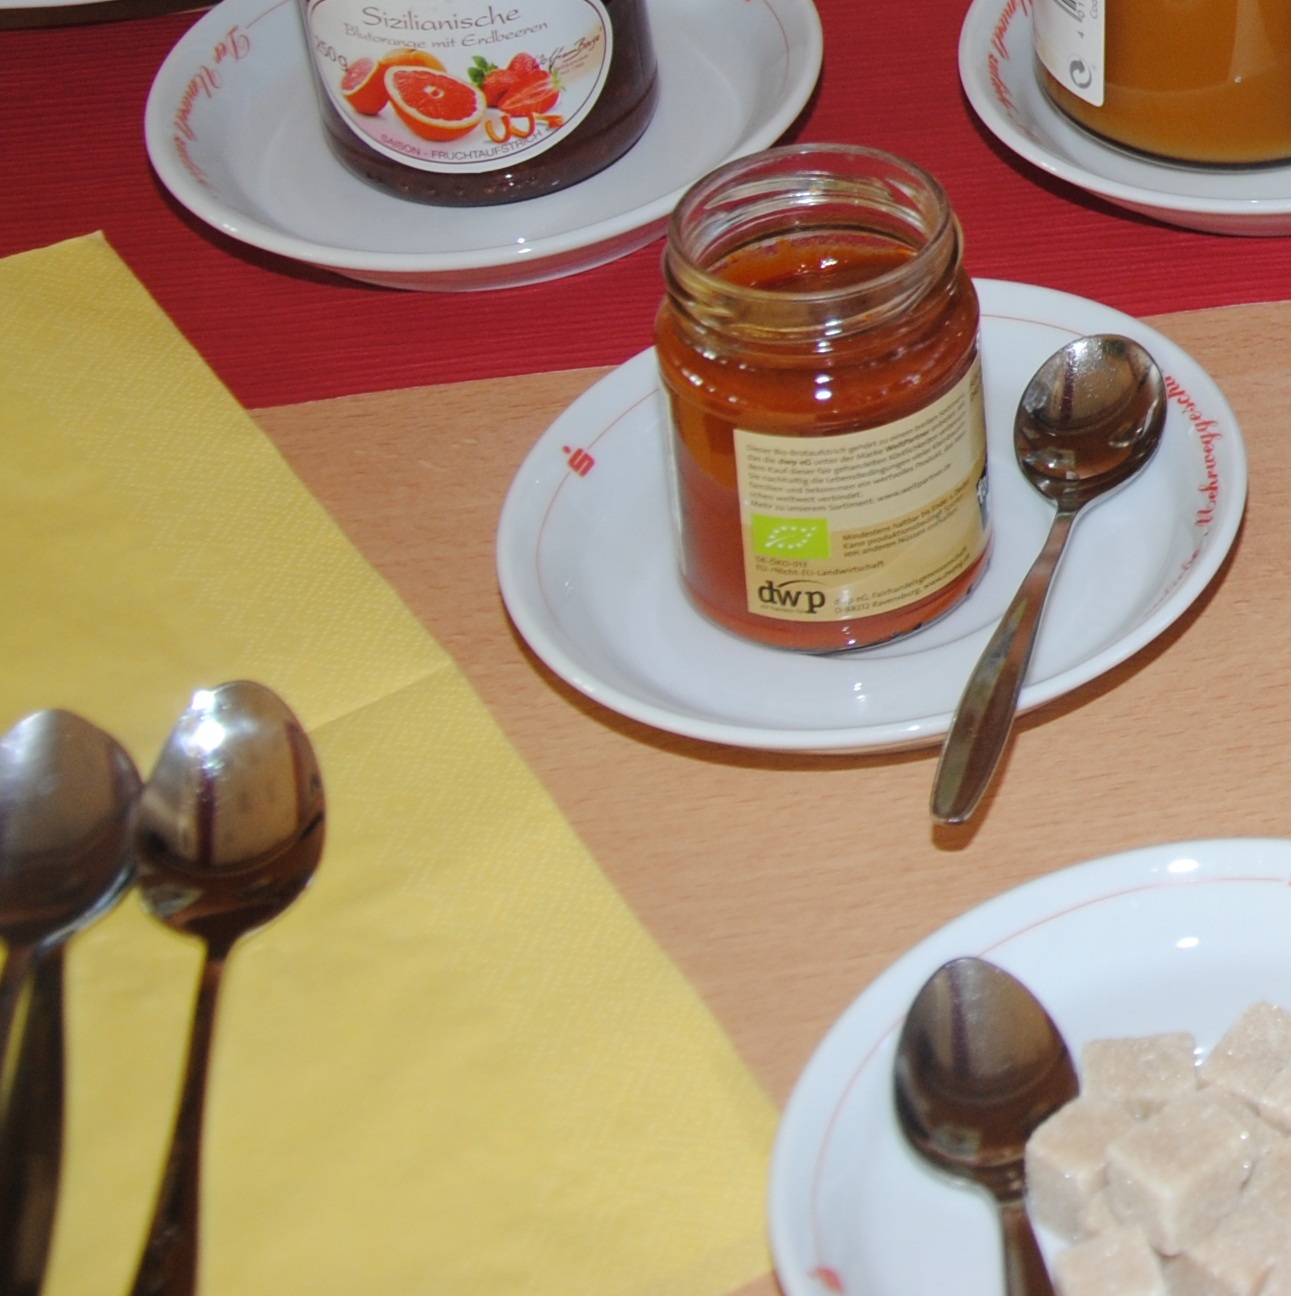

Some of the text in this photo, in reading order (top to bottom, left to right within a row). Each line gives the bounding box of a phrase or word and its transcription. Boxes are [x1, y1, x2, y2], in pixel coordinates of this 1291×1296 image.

[361, 5, 523, 32] Sizilianische
[343, 21, 549, 50] Blutorange mit Erdbeeren
[380, 129, 544, 161] SAISON FRUCHTAUFSTRICH
[757, 580, 827, 615] dwp
